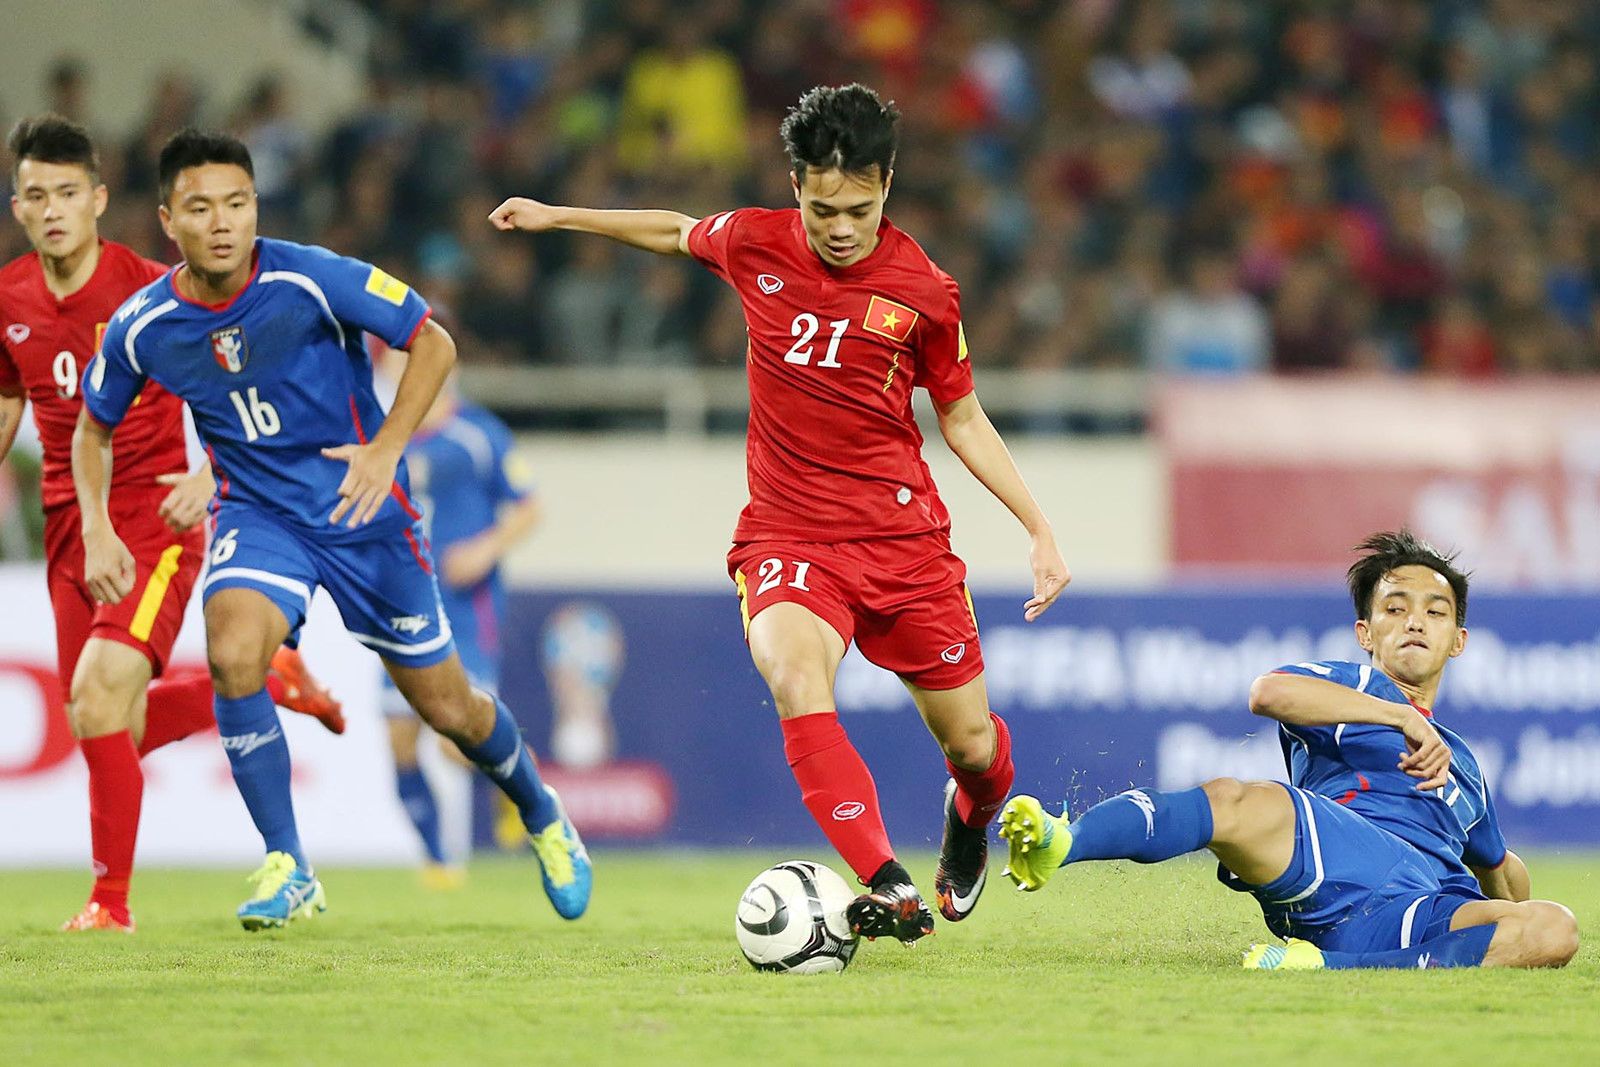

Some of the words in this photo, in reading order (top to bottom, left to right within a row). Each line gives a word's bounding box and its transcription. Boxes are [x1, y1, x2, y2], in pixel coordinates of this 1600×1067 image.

[784, 312, 850, 368] 21
[53, 350, 78, 400] 9
[229, 386, 281, 443] 16
[756, 557, 811, 597] 21
